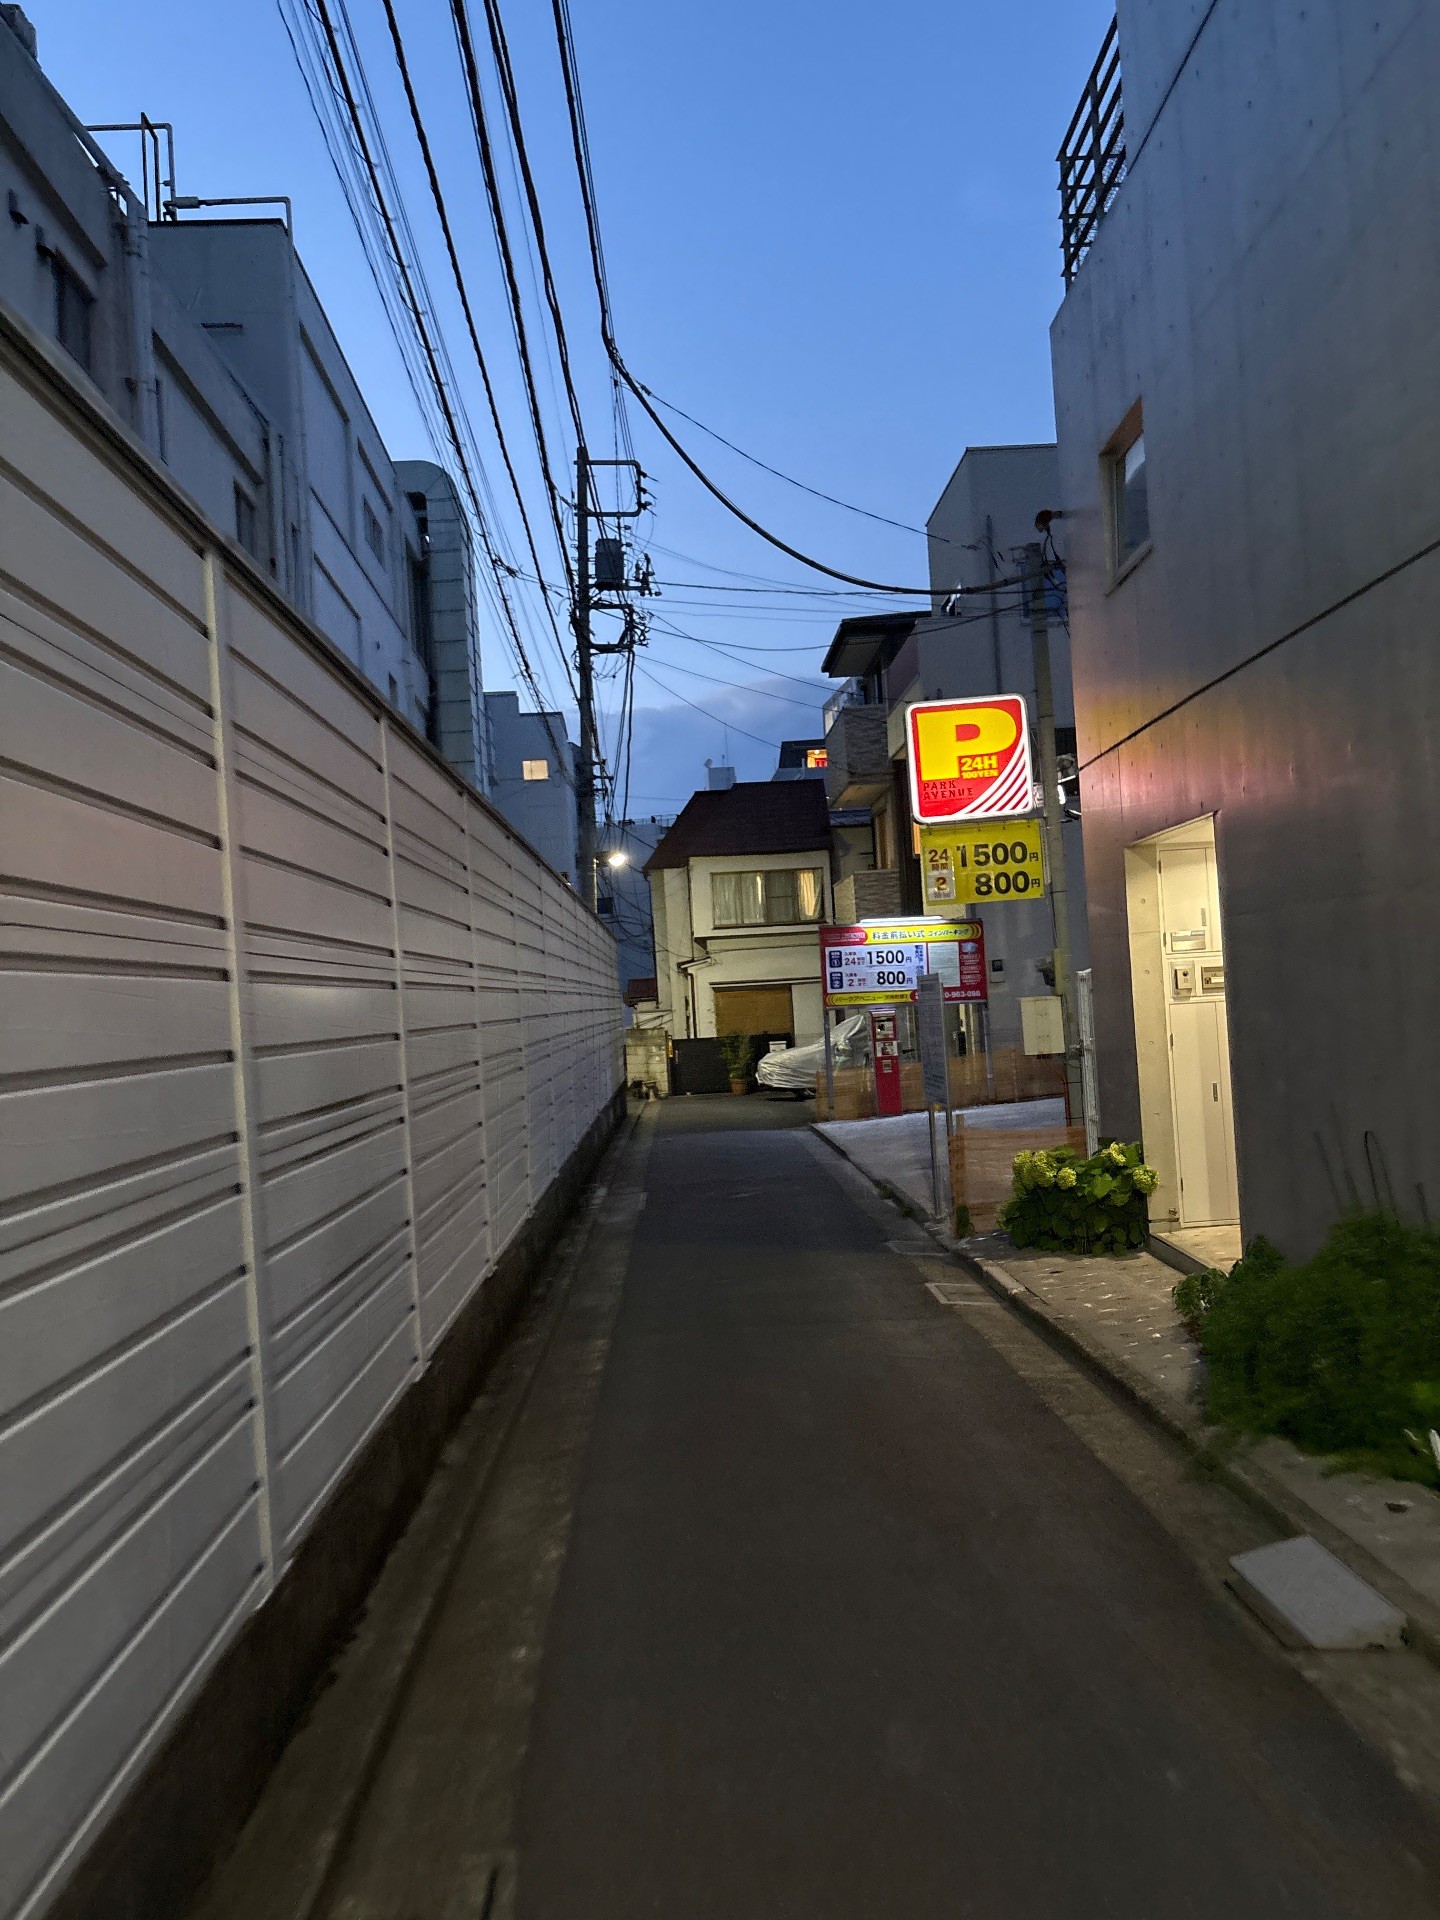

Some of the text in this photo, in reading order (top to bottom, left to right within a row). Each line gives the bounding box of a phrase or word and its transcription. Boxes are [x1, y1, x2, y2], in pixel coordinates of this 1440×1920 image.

[916, 707, 1017, 781] P
[961, 755, 998, 771] 24H
[961, 769, 999, 779] 100YEN
[923, 780, 956, 791] PARK
[923, 788, 974, 800] AVENUE
[929, 849, 949, 863] 24
[935, 877, 948, 891] 2
[975, 870, 1041, 896] 800円
[844, 958, 856, 966] 24
[848, 979, 855, 987] 2
